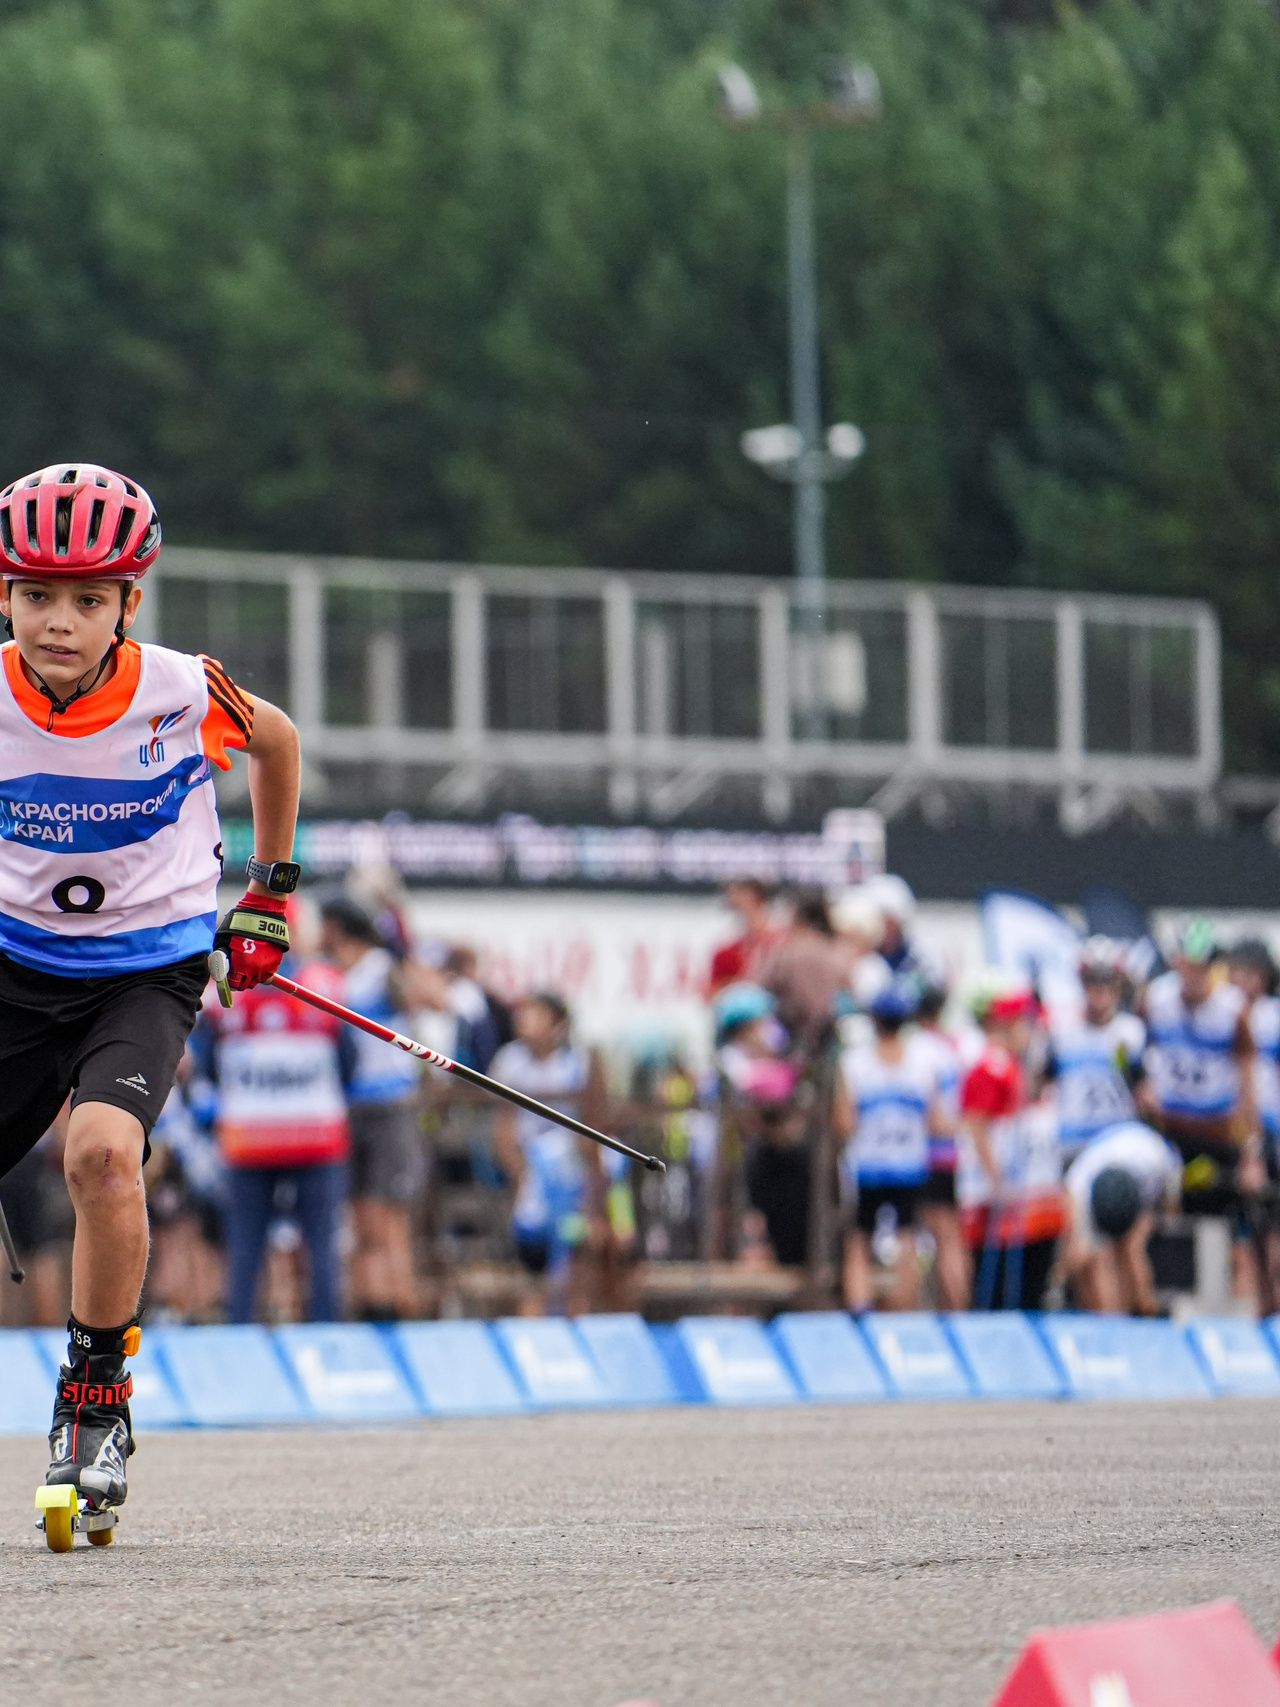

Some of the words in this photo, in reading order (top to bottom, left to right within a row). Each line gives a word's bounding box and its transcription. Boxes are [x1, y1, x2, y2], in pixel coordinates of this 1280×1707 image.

[14, 821, 74, 843] КРАЙ
[258, 920, 286, 937] HIDE
[72, 1327, 92, 1349] 158
